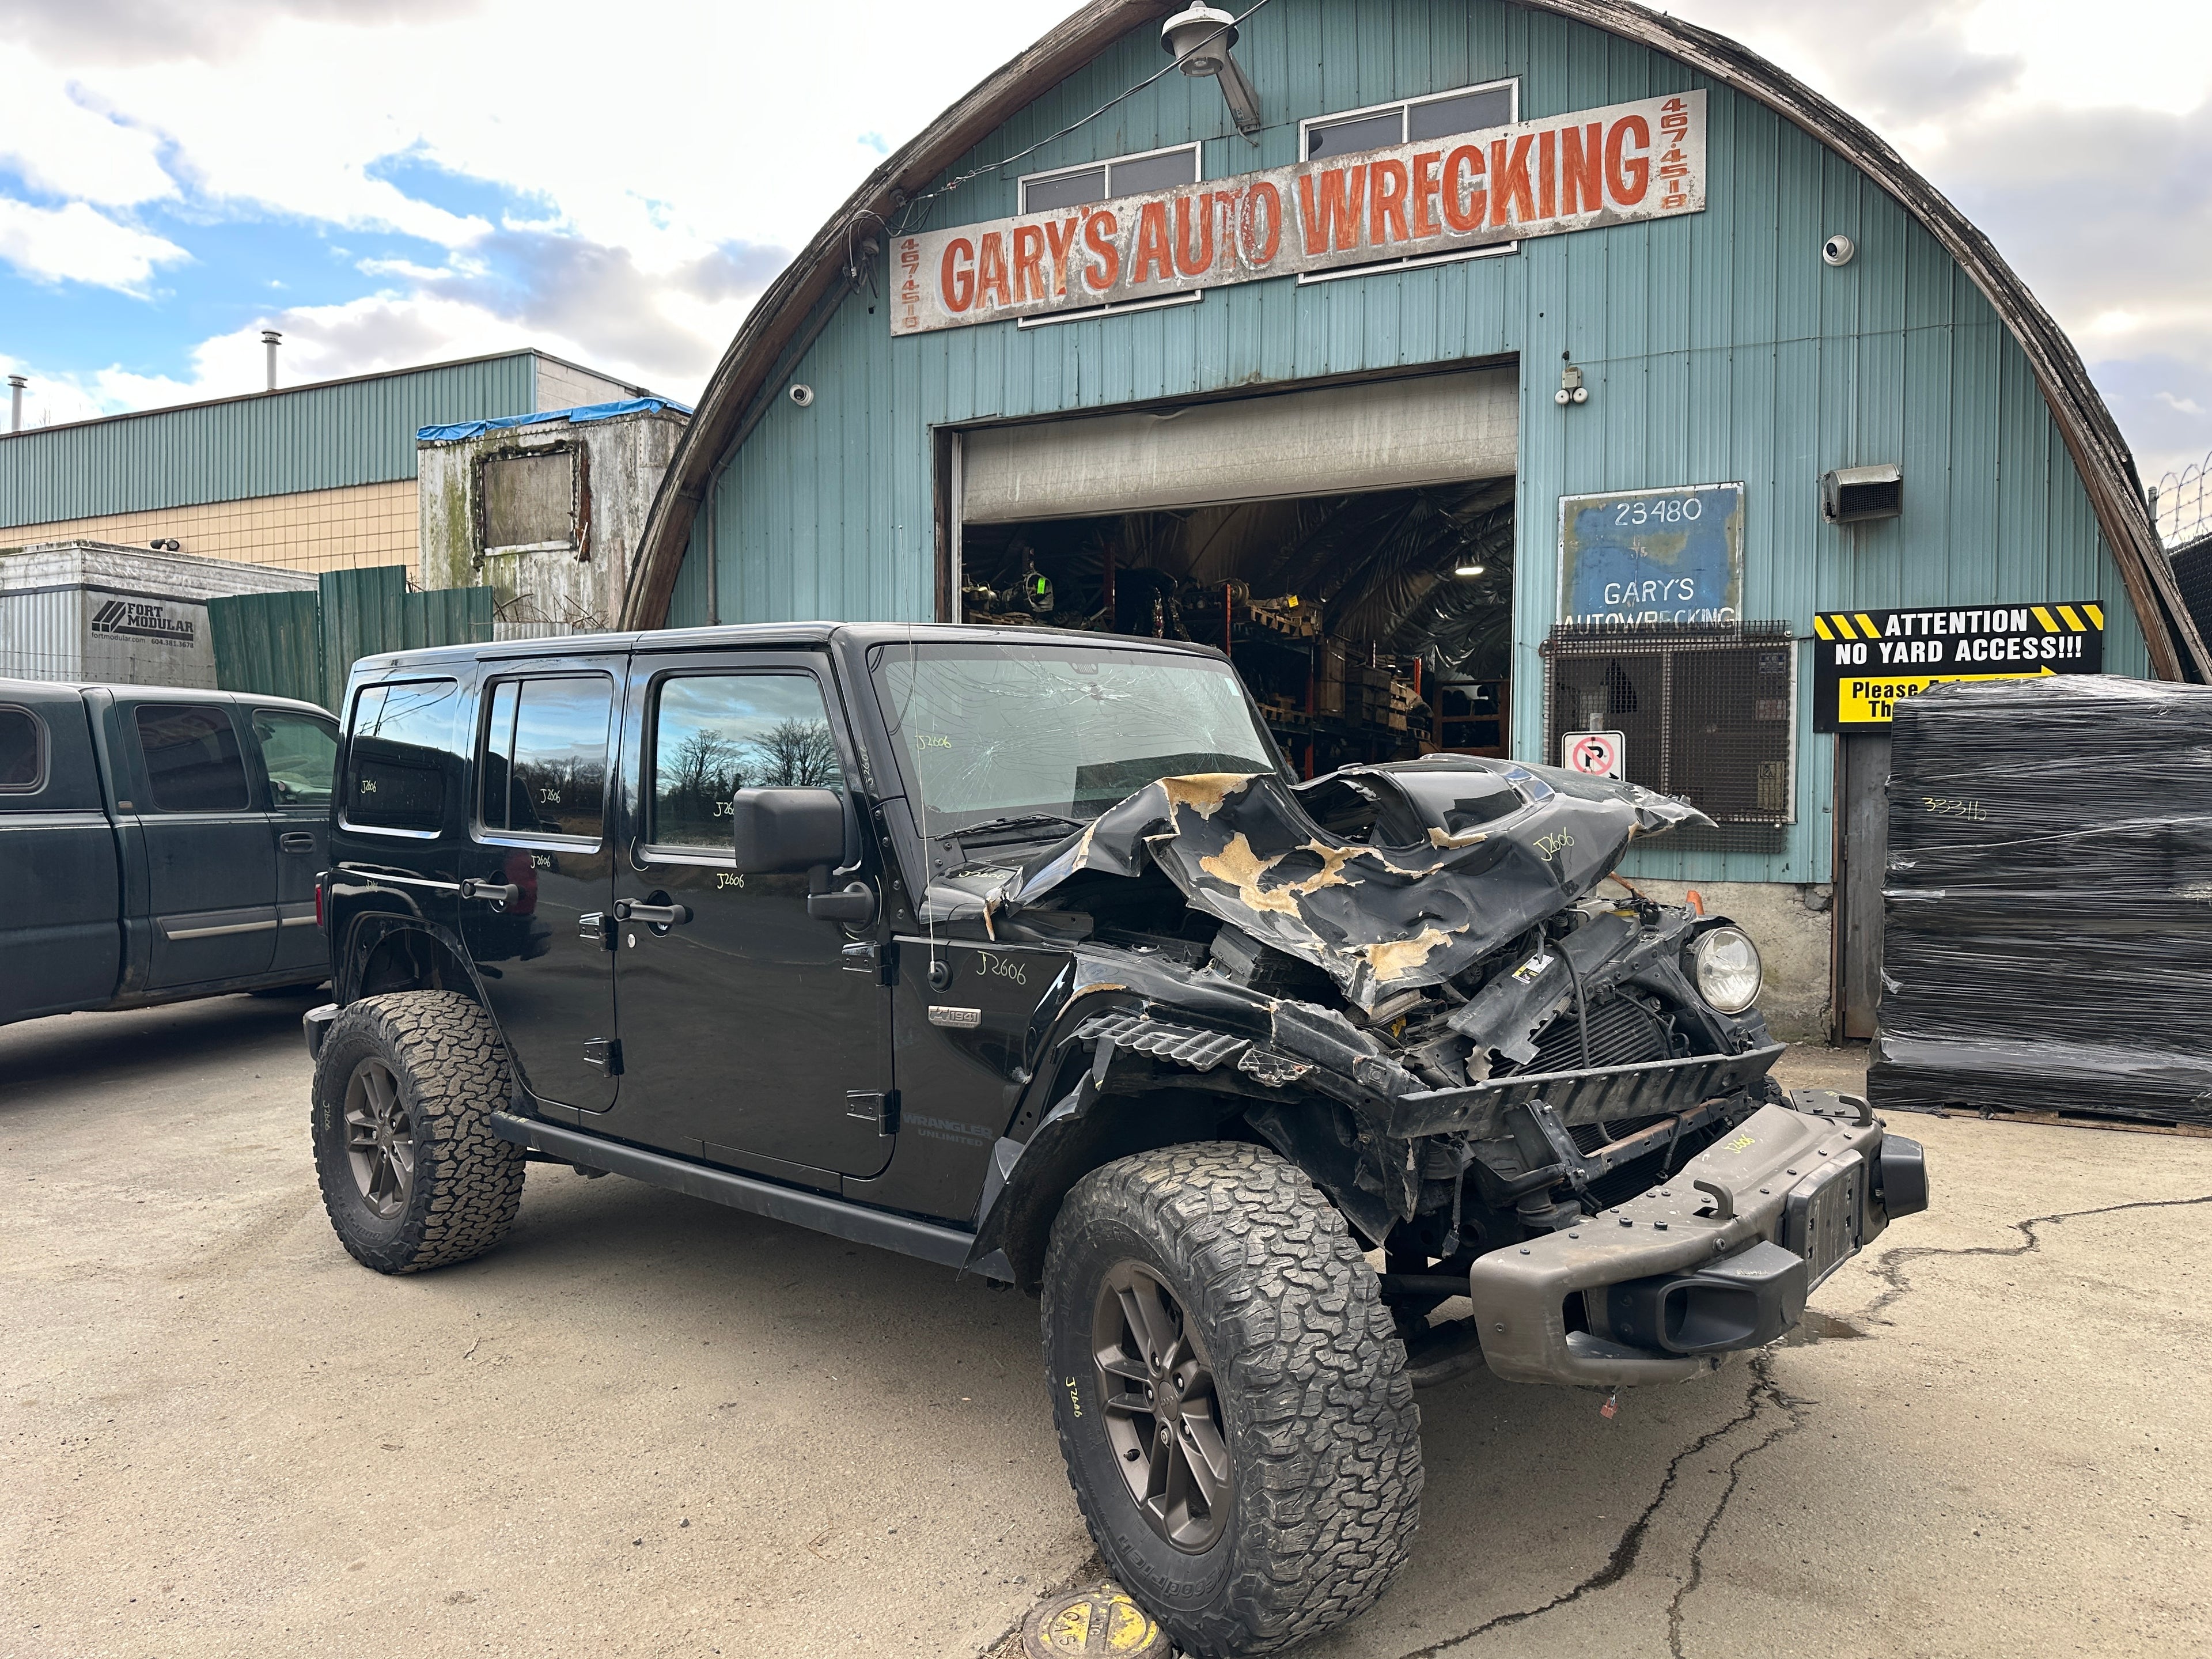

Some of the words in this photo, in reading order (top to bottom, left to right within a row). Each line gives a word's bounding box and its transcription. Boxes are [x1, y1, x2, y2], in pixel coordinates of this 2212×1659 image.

[940, 206, 1119, 312] GARY'S
[1134, 181, 1281, 283] AUTO
[1299, 115, 1650, 255] WRECKING
[1615, 498, 1702, 526] 23480
[1604, 578, 1694, 604] GARY'S
[127, 603, 163, 618] FORT
[127, 615, 194, 632] MODULAR
[1885, 609, 2028, 637] ATTENTION
[92, 632, 145, 643] fortmodular.com
[151, 638, 194, 649] 604.381.3678
[1835, 642, 1867, 665] NO
[1878, 641, 1943, 664] YARD
[1955, 635, 2082, 661] ACCESS!!!
[1853, 681, 1918, 699] Please
[914, 735, 952, 750] J2606
[540, 788, 561, 804] J2606
[713, 801, 734, 817] J26
[530, 854, 551, 869] J2606
[716, 873, 744, 889] J2606
[959, 870, 1006, 879] J2606
[976, 950, 1027, 985] J2606
[950, 1011, 977, 1022] 1941
[903, 1112, 994, 1140] WRANGLER
[918, 1128, 983, 1147] UNLIMITED
[1054, 1611, 1080, 1646] GAS
